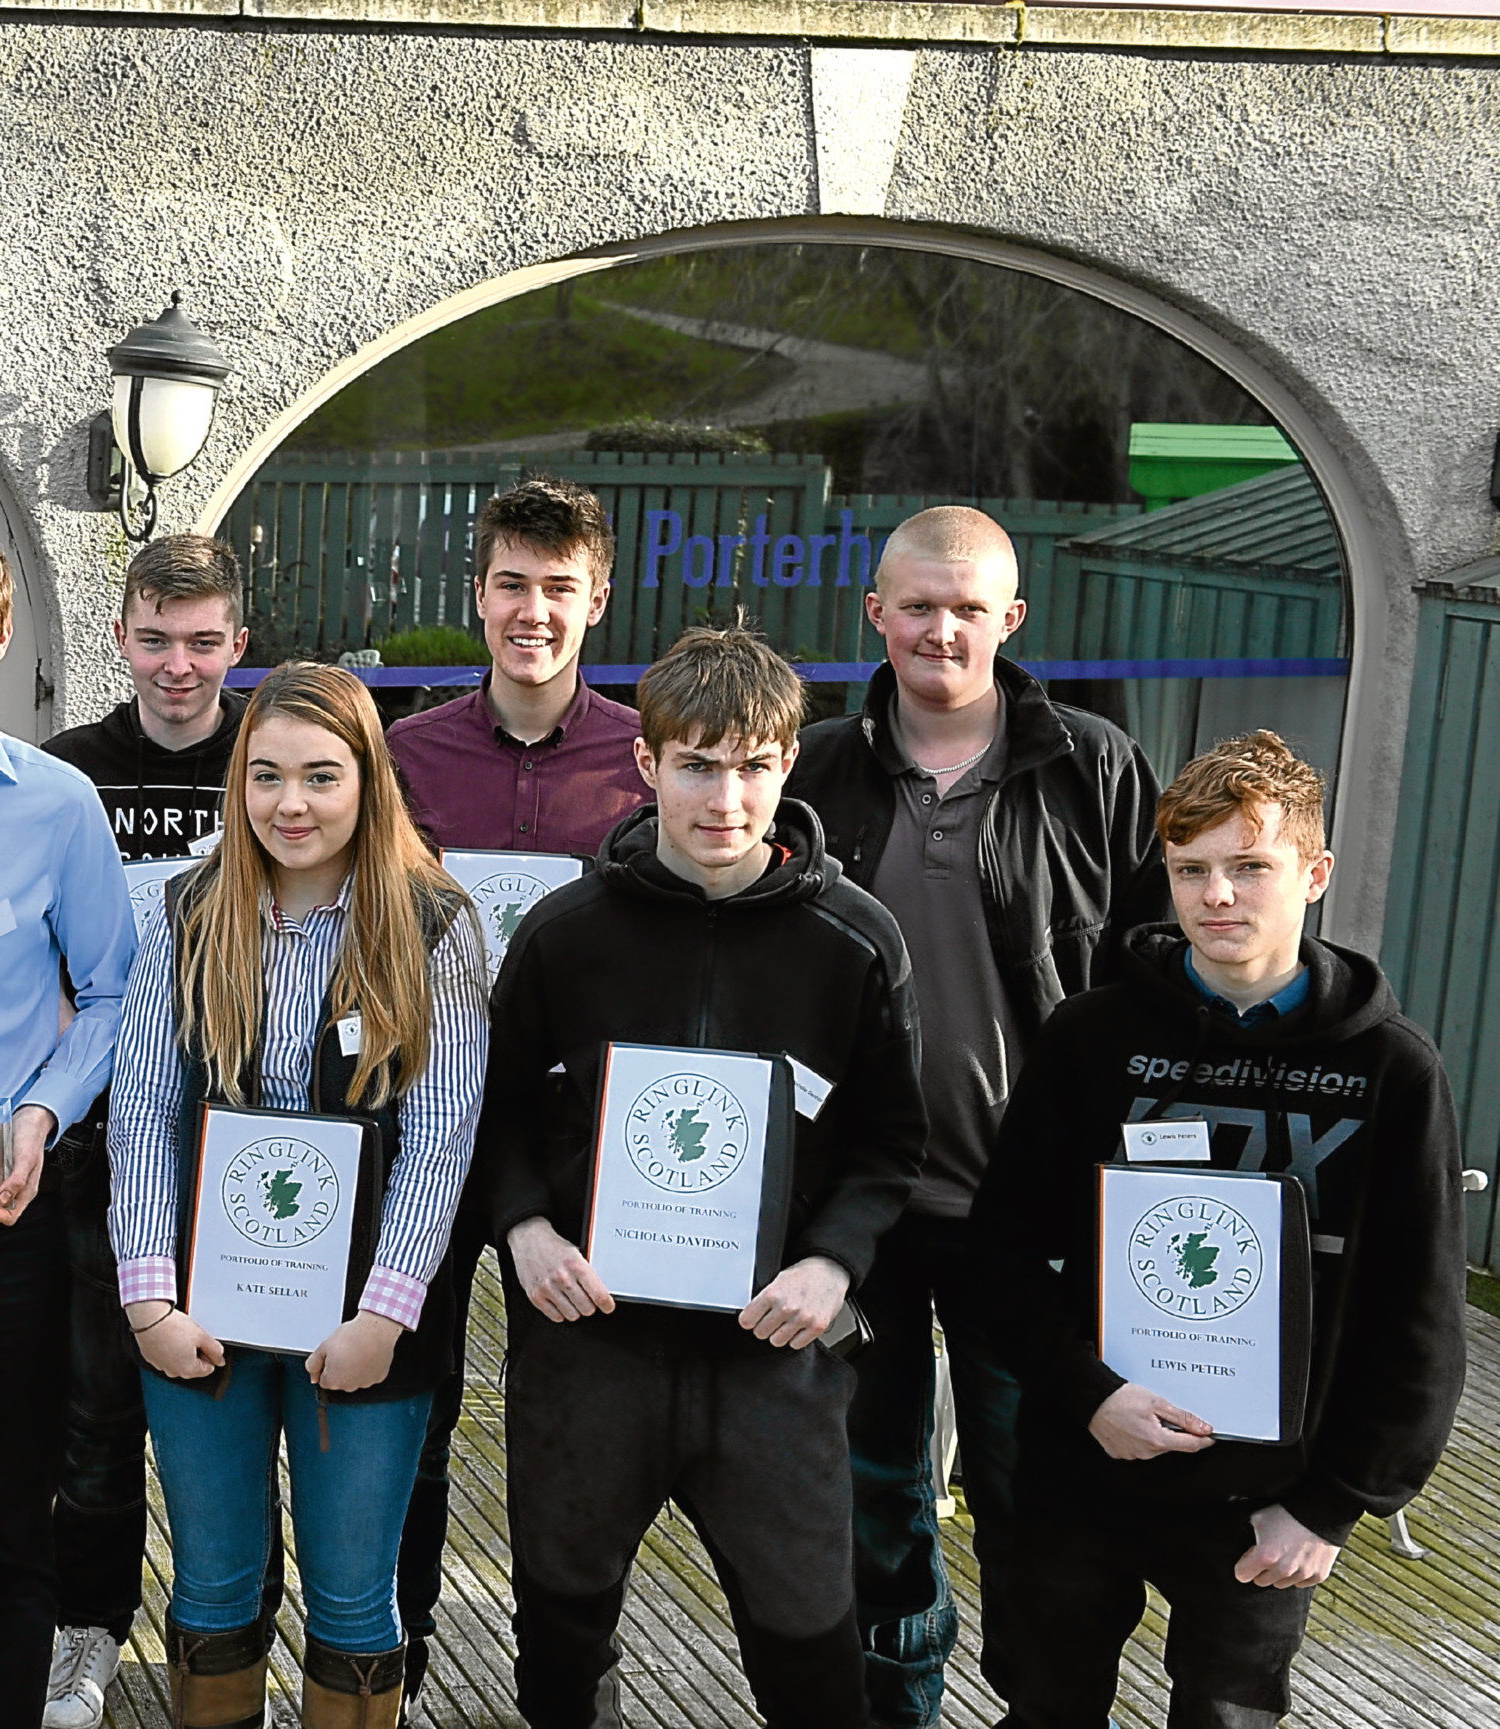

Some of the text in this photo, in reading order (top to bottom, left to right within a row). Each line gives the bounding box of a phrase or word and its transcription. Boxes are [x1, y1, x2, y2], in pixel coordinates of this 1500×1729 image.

[642, 510, 887, 588] Porterh
[1127, 1054, 1367, 1097] speedivision
[633, 1079, 744, 1130] RINGLINK
[229, 1142, 335, 1192] RINGLINK
[633, 1134, 739, 1188] SCOTLAND
[229, 1192, 329, 1243] SCOTLAND
[621, 1200, 673, 1212] PORTFOLIO
[690, 1207, 737, 1219] TRAINING
[1135, 1202, 1257, 1255] RINGLINK
[614, 1228, 740, 1250] NICHOLAS DAVIDSON
[220, 1254, 269, 1267] PORTFOLIO
[285, 1260, 329, 1272] TRAINING
[236, 1282, 308, 1298] KATE SELLAR
[1137, 1258, 1252, 1315] SCOTLAND
[1131, 1327, 1187, 1341] PORTFOLIO
[1205, 1334, 1257, 1347] TRAINING
[1150, 1359, 1237, 1377] LEWIS PETERS
